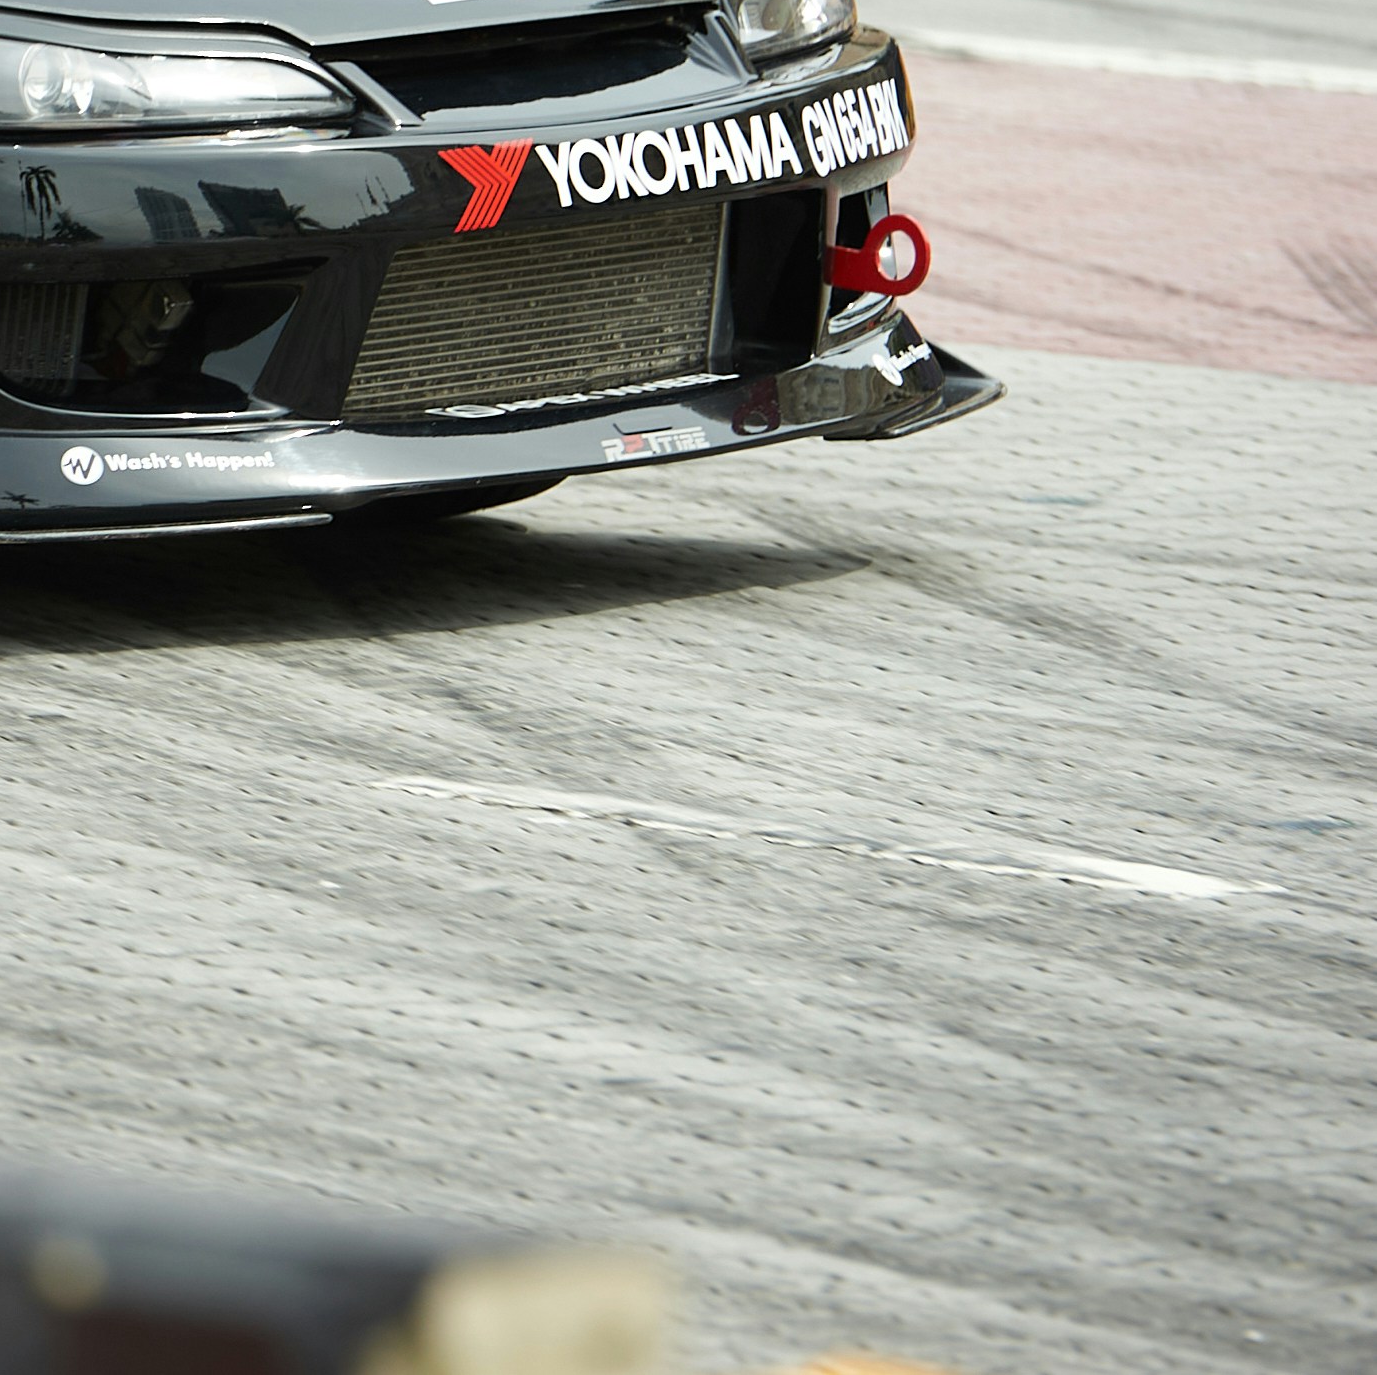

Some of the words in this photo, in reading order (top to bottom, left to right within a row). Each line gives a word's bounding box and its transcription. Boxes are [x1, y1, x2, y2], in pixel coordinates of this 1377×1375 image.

[534, 111, 803, 208] YOKOHAMA
[104, 453, 182, 471] Wash's
[185, 451, 276, 471] Happen!
